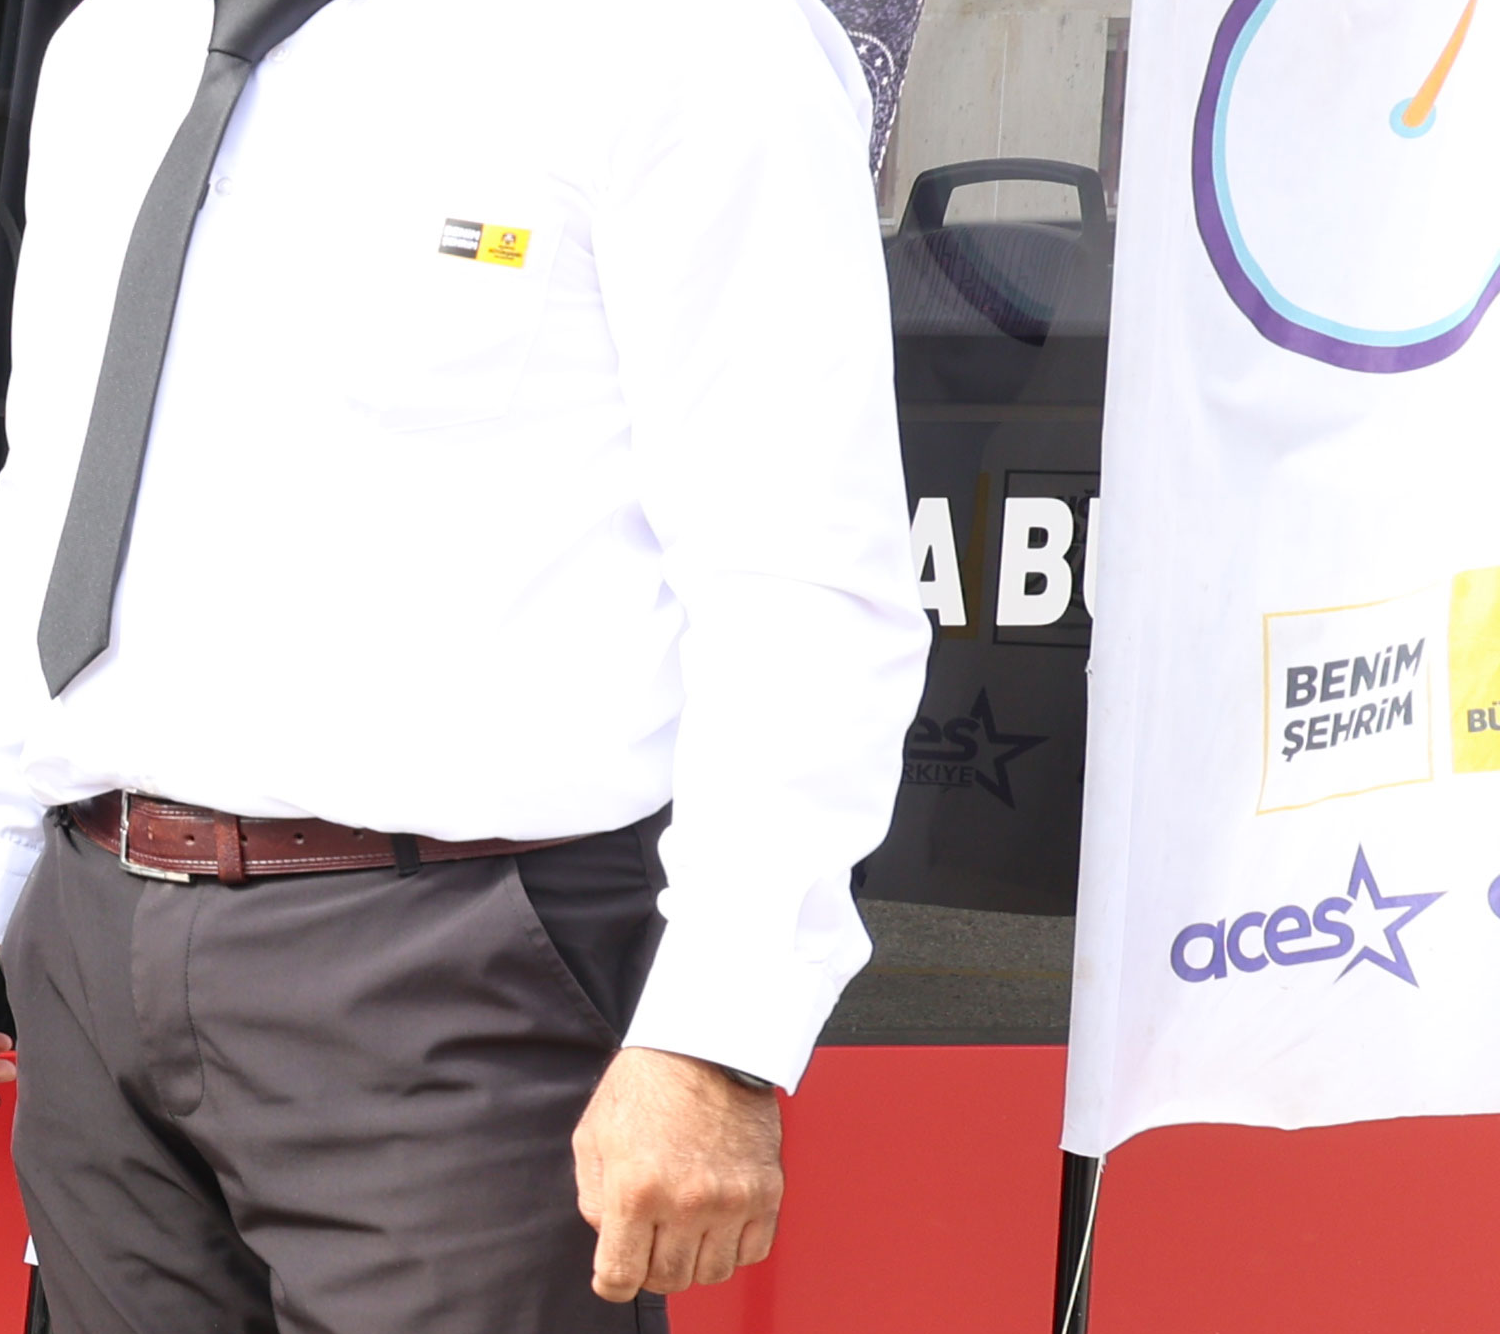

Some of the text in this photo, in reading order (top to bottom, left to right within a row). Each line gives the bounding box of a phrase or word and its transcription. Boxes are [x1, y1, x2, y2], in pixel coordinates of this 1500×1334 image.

[1285, 637, 1426, 709] BENİM
[1281, 690, 1414, 763] ŞEHRİM
[1170, 896, 1355, 983] aces
